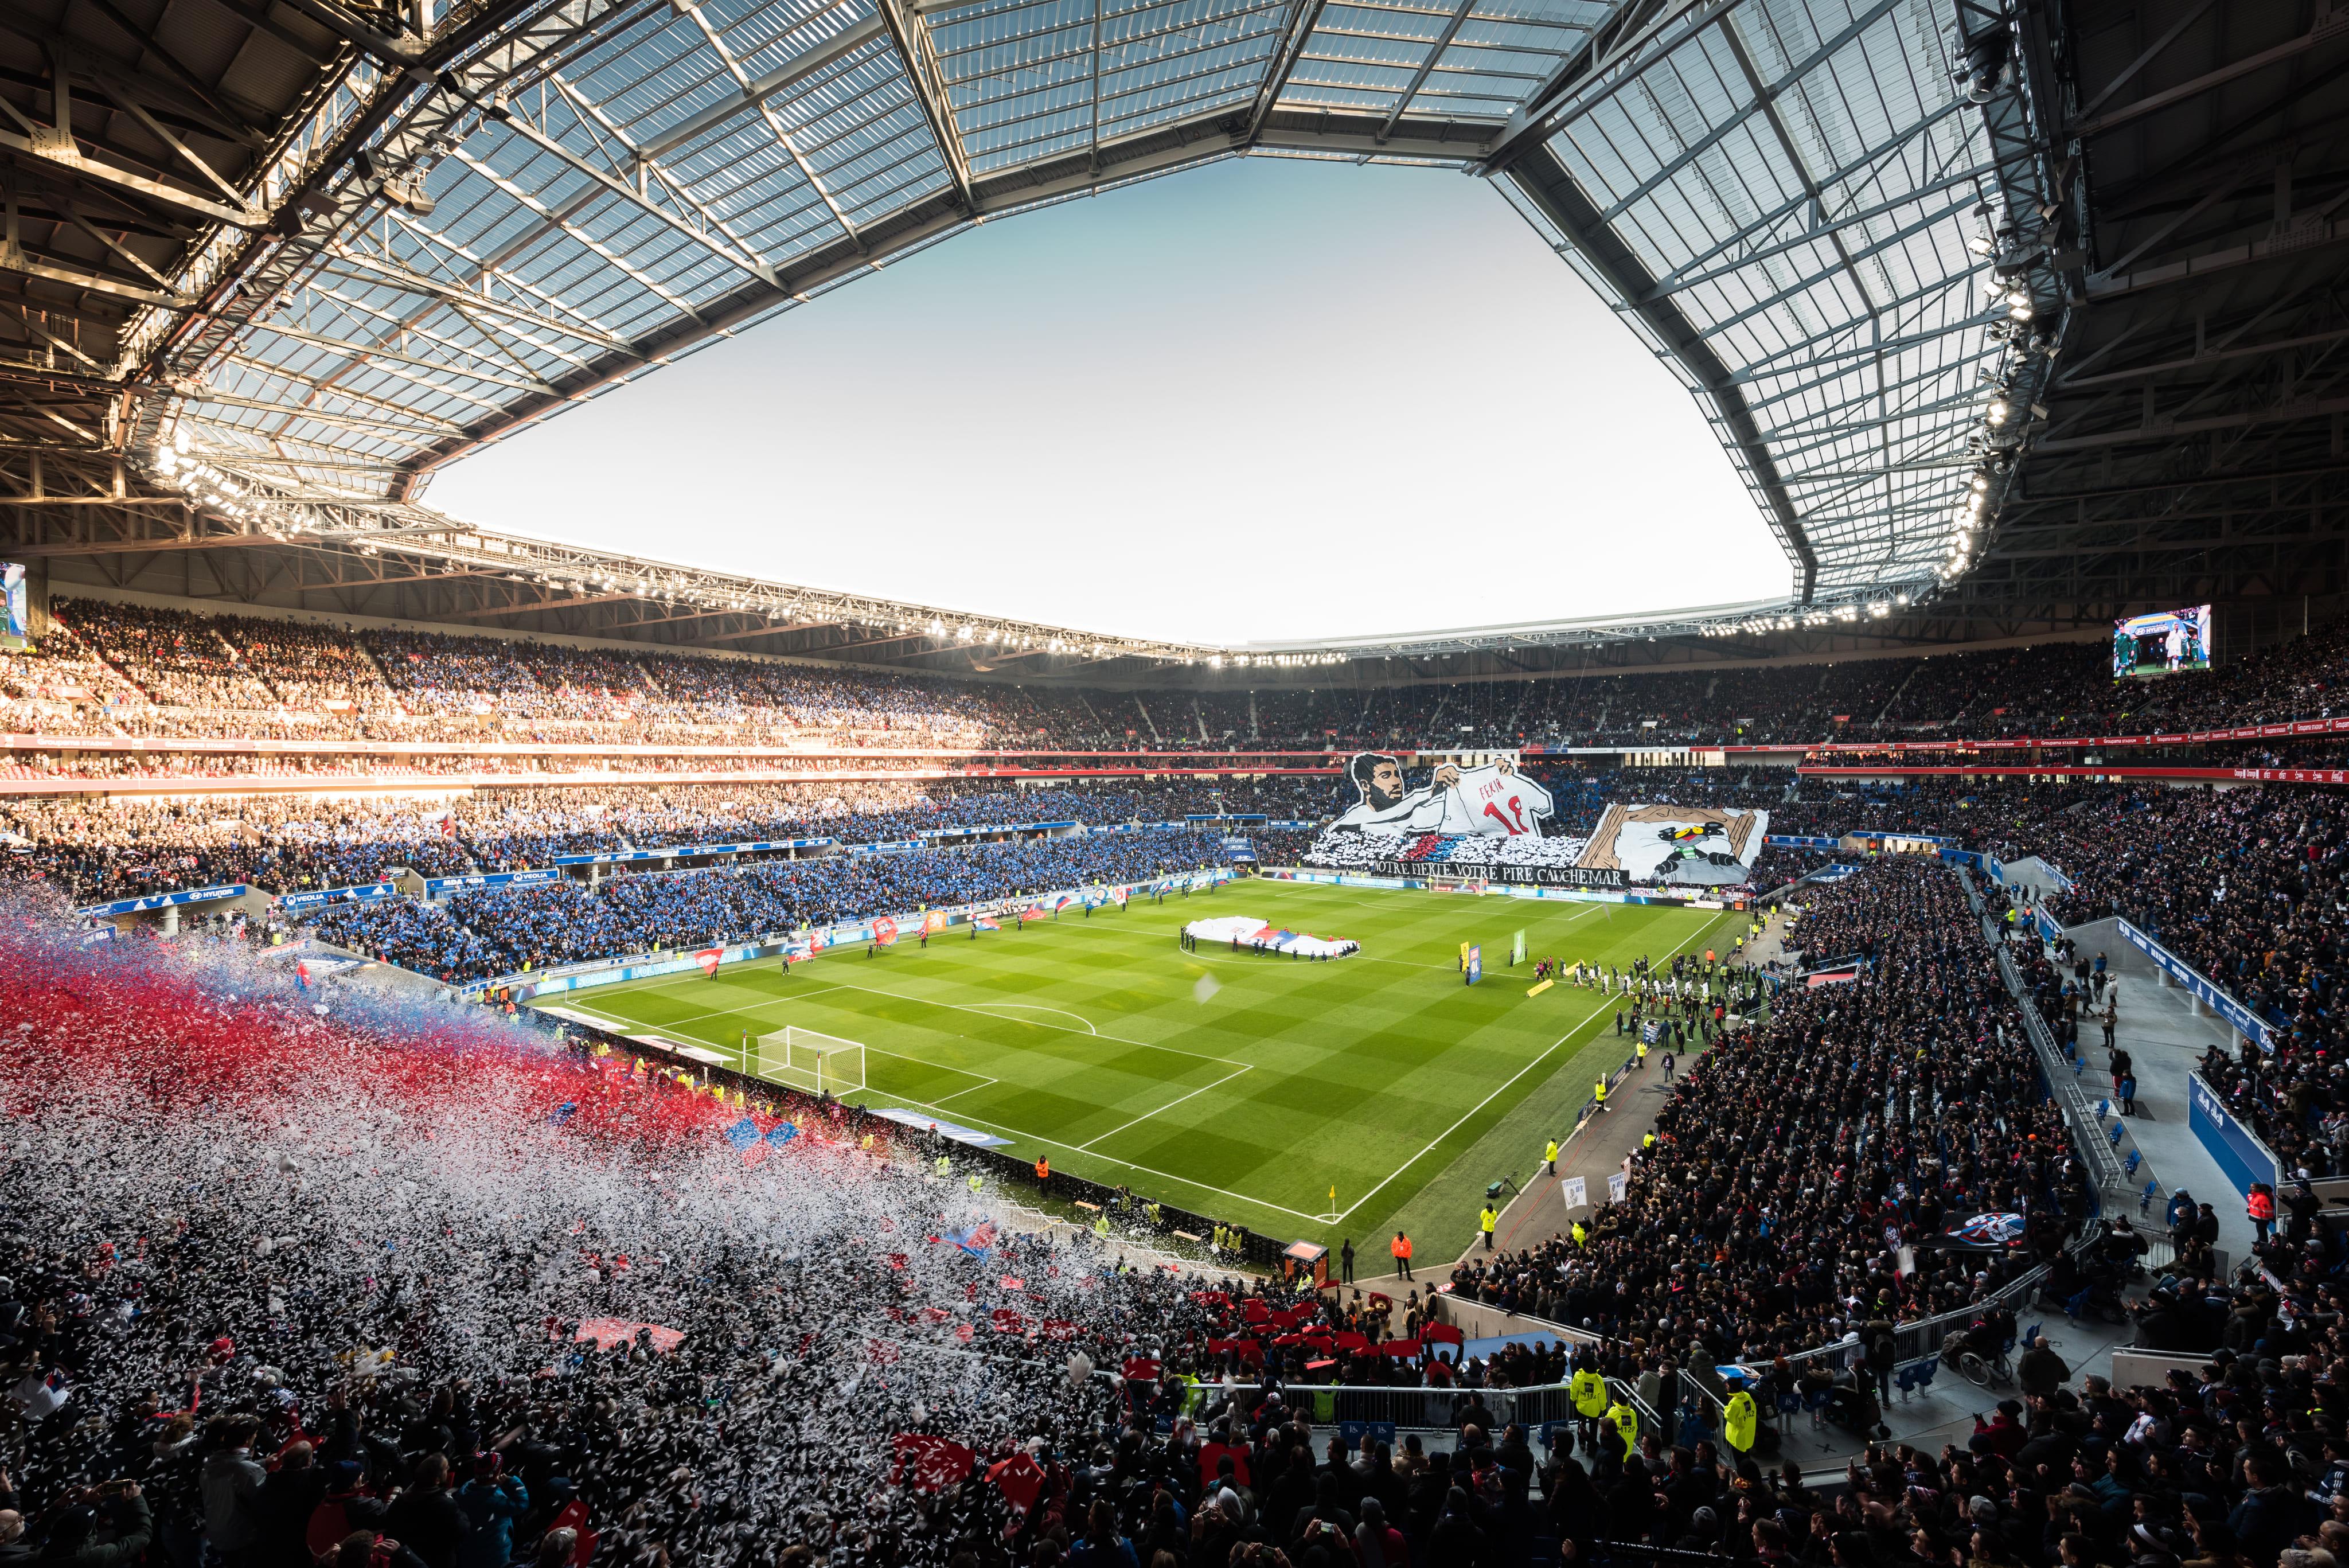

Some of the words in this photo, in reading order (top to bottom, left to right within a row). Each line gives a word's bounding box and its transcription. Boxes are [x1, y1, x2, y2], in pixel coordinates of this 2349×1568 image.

[1479, 778, 1504, 800] FEKIR
[1456, 864, 1497, 880] VOTRE
[1503, 867, 1533, 881] PIRE
[1538, 869, 1623, 886] CAUCHEMAR
[203, 888, 233, 898] HYUNDAI
[296, 894, 324, 902] VEOLIA
[576, 969, 622, 988] SOMMES
